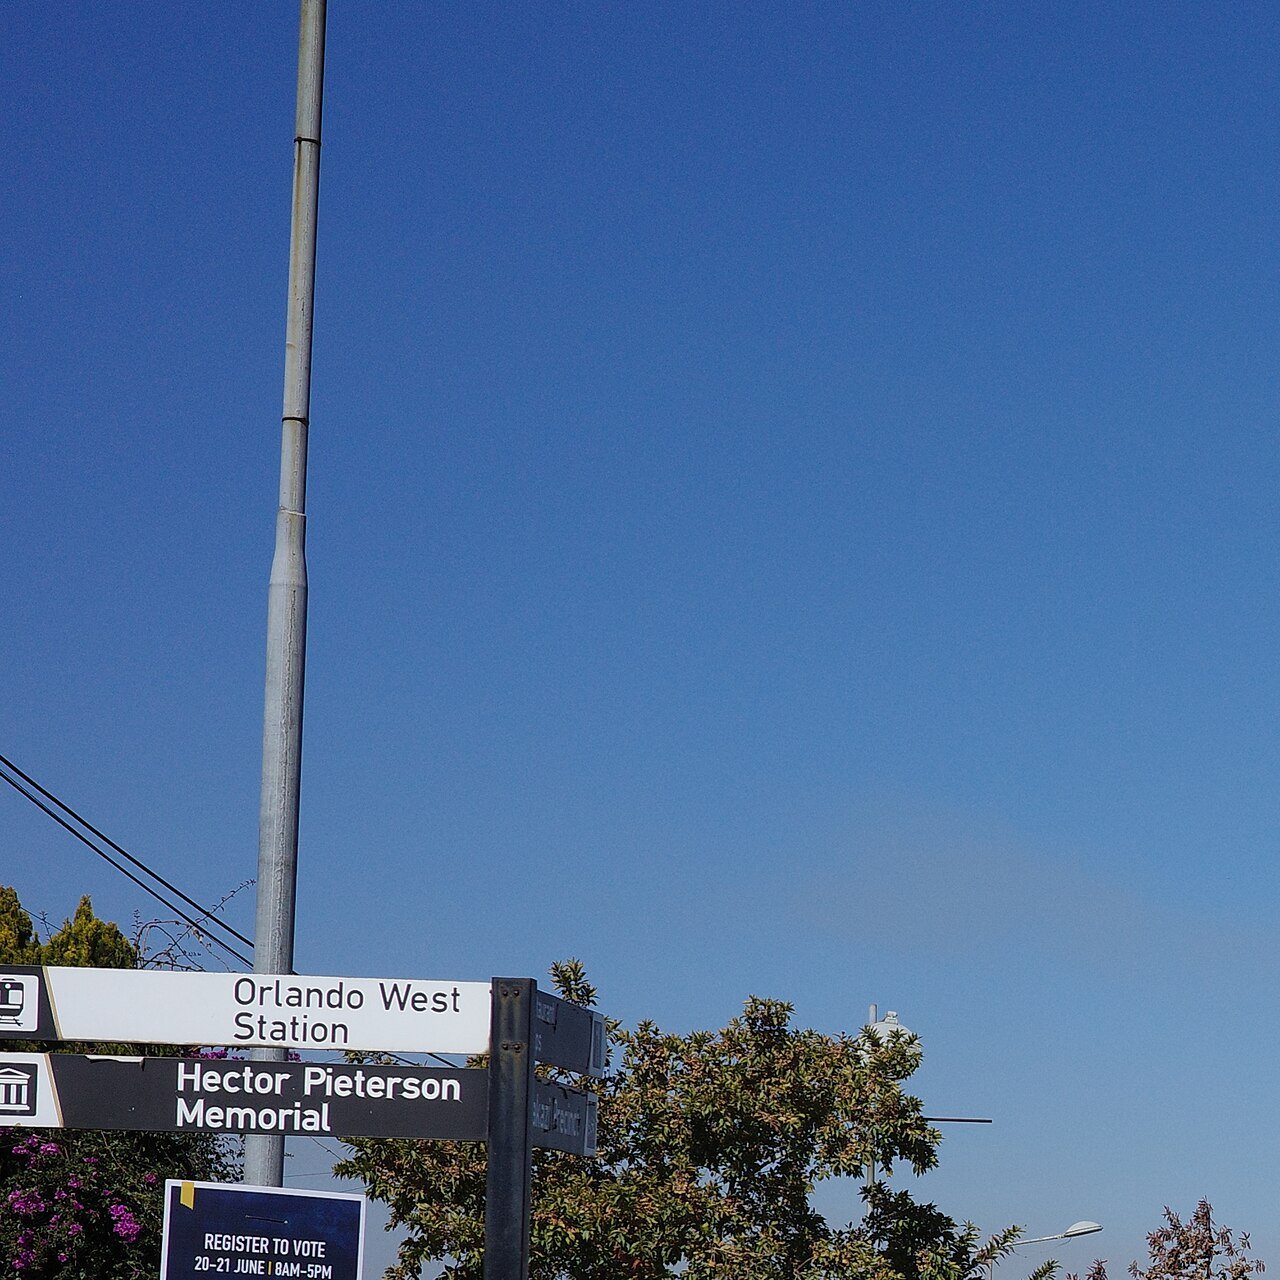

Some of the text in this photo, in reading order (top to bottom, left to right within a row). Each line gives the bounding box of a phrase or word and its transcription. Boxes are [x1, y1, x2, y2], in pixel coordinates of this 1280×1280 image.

[234, 977, 461, 1013] Orlando West
[233, 1012, 349, 1044] Station
[177, 1063, 462, 1101] Hector Pieterson
[176, 1098, 331, 1132] Memorial
[204, 1233, 326, 1258] REGISTER TO VOTE
[233, 1259, 265, 1275] JUNE
